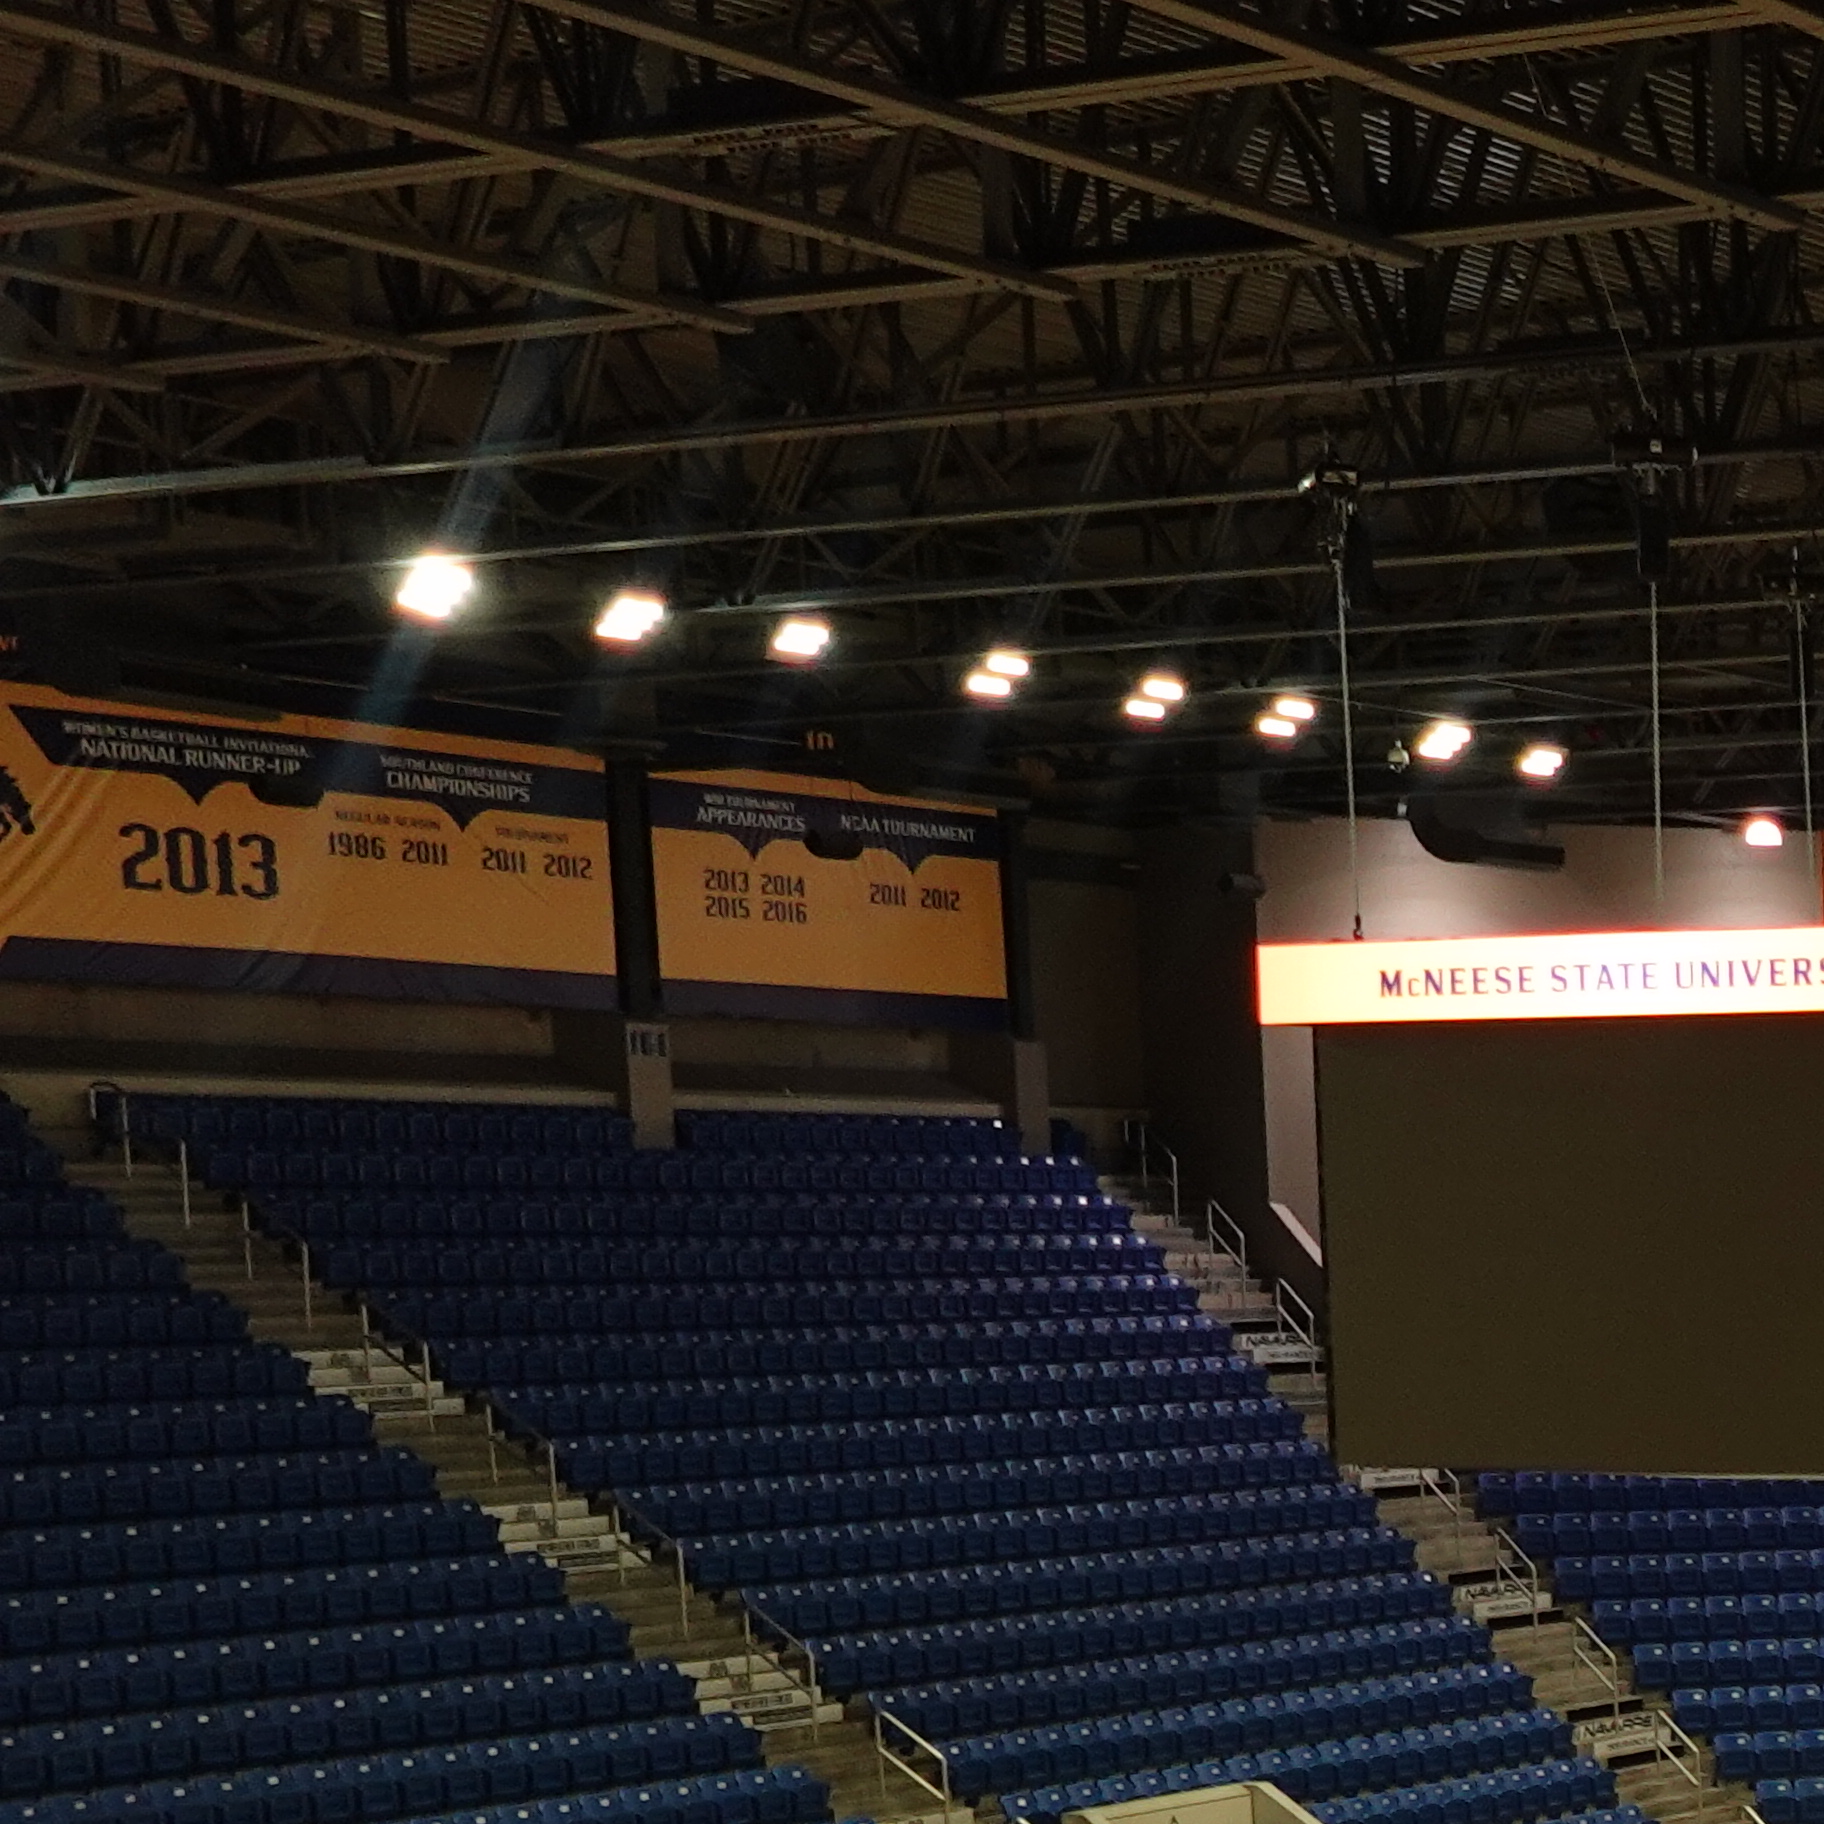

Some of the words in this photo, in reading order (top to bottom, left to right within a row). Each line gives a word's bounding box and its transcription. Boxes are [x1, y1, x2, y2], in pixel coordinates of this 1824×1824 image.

[81, 738, 181, 766] NATIONAL
[185, 748, 301, 775] RUNNER-UP
[385, 770, 531, 803] CHAMPIONSHIPS
[697, 806, 807, 833] APPEARANCES
[840, 814, 881, 834] NCAA
[881, 817, 977, 844] TOURNAMENT
[118, 822, 280, 900] 2013
[327, 831, 387, 860] 1986
[401, 839, 449, 867] 2011
[481, 847, 527, 874] 2011
[542, 853, 594, 880] 2012
[703, 868, 750, 893] 2013
[760, 873, 807, 899] 2014
[869, 882, 907, 908] 2011
[920, 888, 961, 912] 2012
[704, 896, 751, 920] 2015
[762, 900, 808, 925] 2016
[1379, 964, 1537, 998] McNEESE
[1550, 962, 1659, 993] STATE
